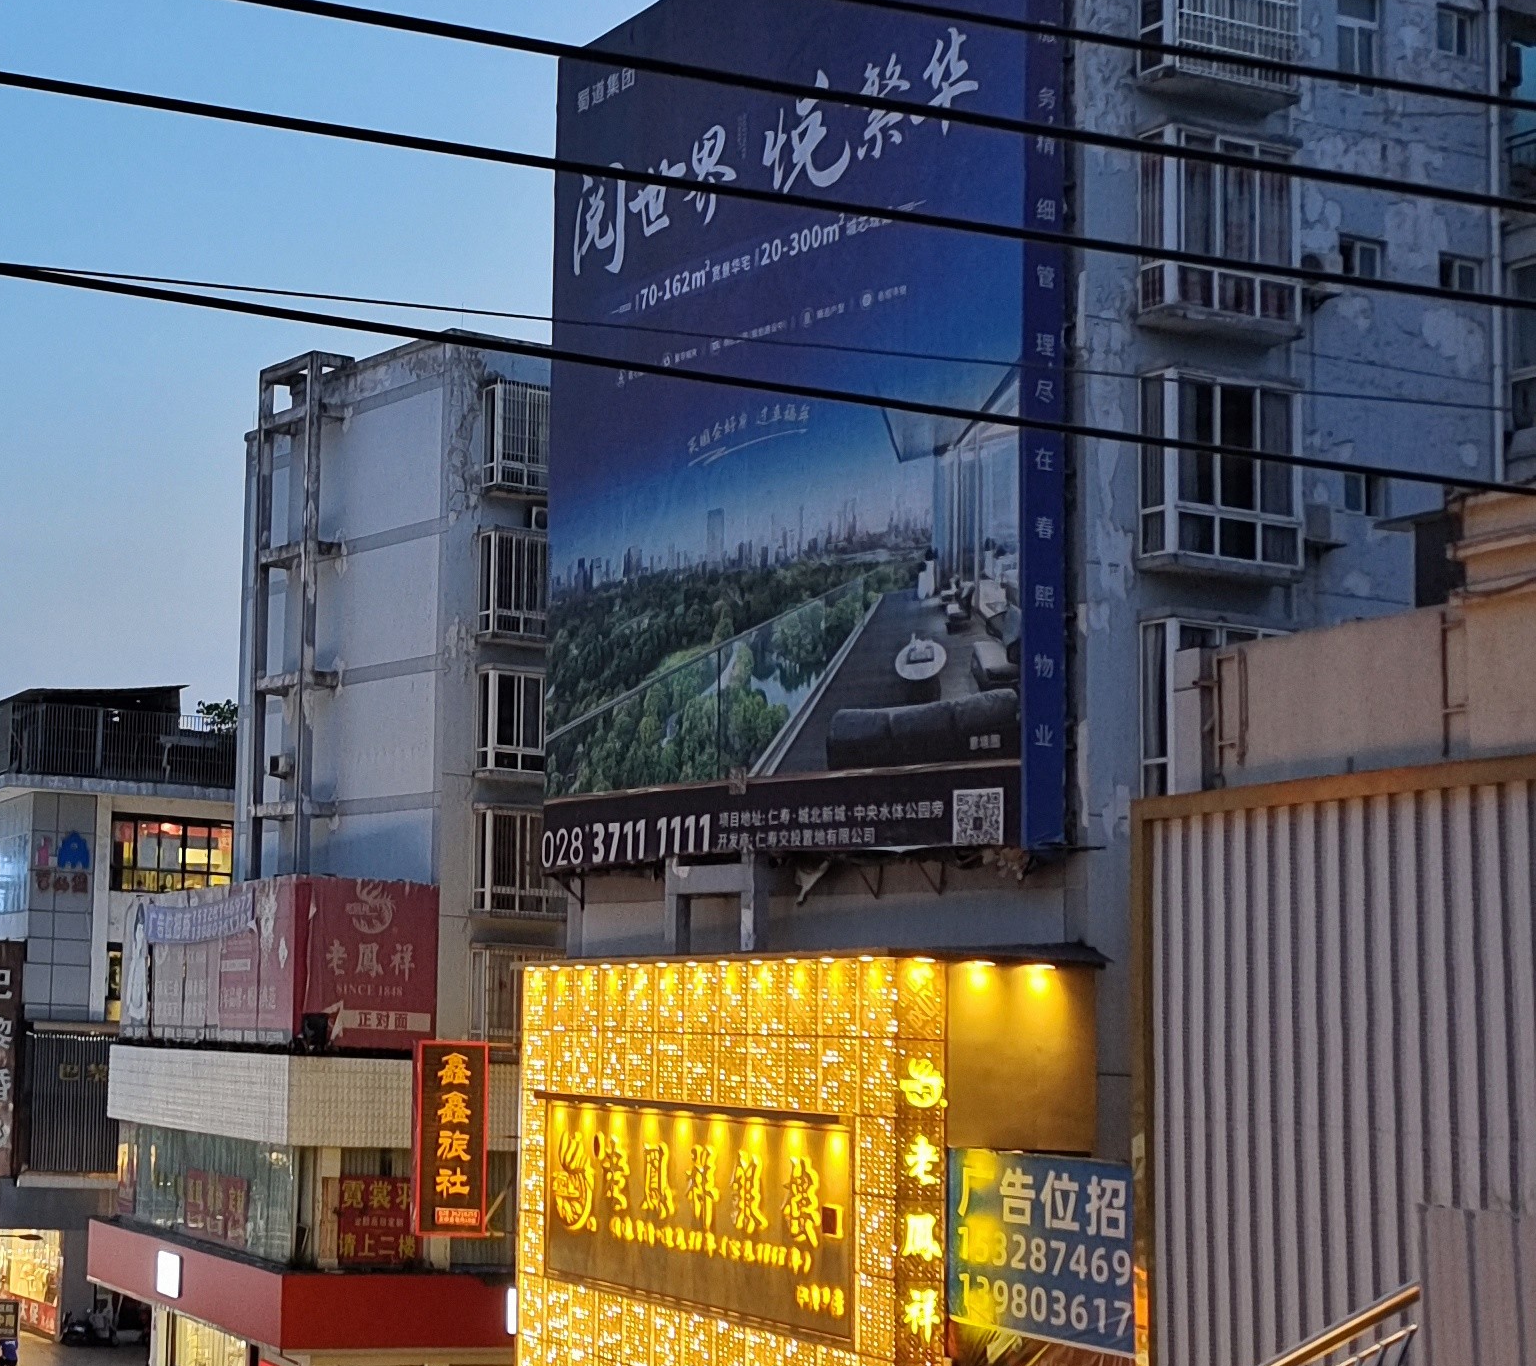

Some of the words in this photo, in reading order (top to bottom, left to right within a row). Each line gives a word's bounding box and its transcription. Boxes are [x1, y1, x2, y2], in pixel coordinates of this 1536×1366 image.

[577, 68, 635, 112] 蜀道集团
[335, 985, 374, 997] SINCE
[377, 985, 403, 998] 1848
[357, 1011, 409, 1030] 正对面
[435, 1051, 472, 1199] 鑫鑫旅社
[957, 1165, 1128, 1240] 广告位招
[338, 1232, 415, 1259] 请上二楼
